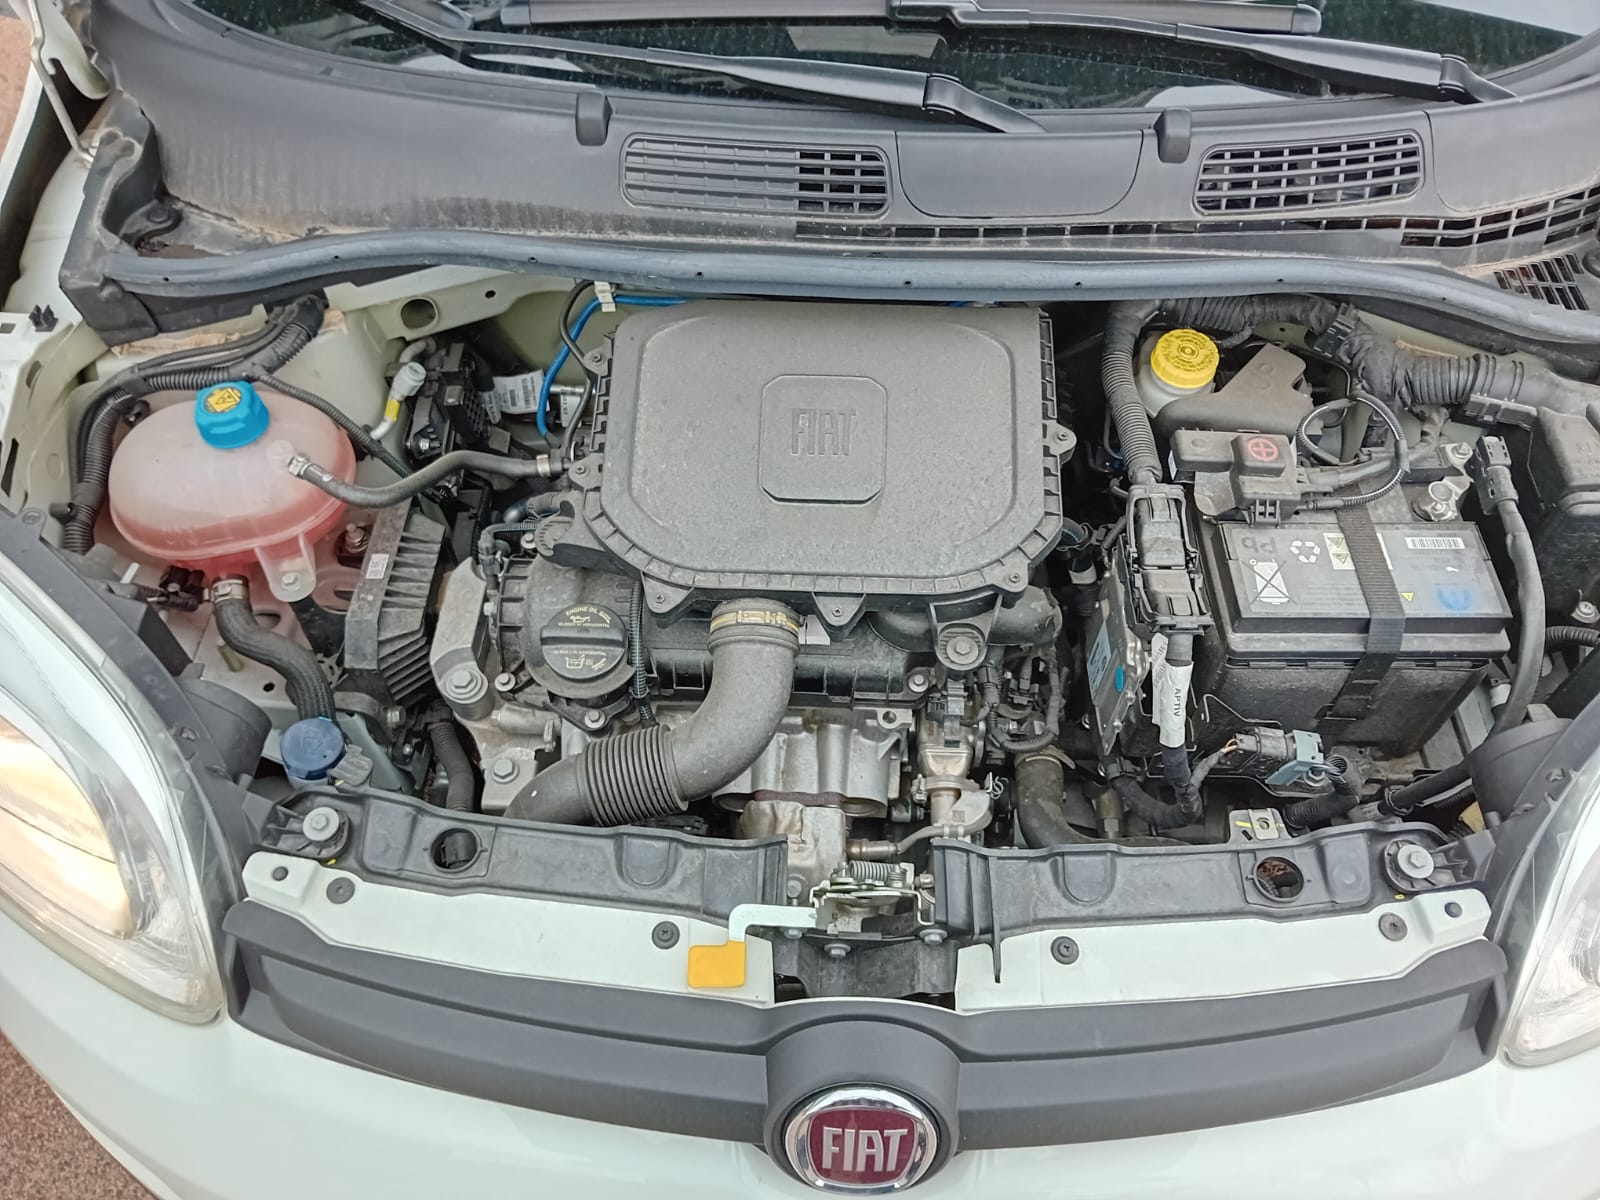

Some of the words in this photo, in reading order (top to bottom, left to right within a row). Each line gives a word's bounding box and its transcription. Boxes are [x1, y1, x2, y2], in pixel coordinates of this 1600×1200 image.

[791, 407, 857, 457] FIAT
[565, 606, 588, 616] ENGINE
[588, 606, 598, 614] OIL
[1173, 688, 1182, 717] APTIV
[822, 1126, 908, 1172] FIAT
